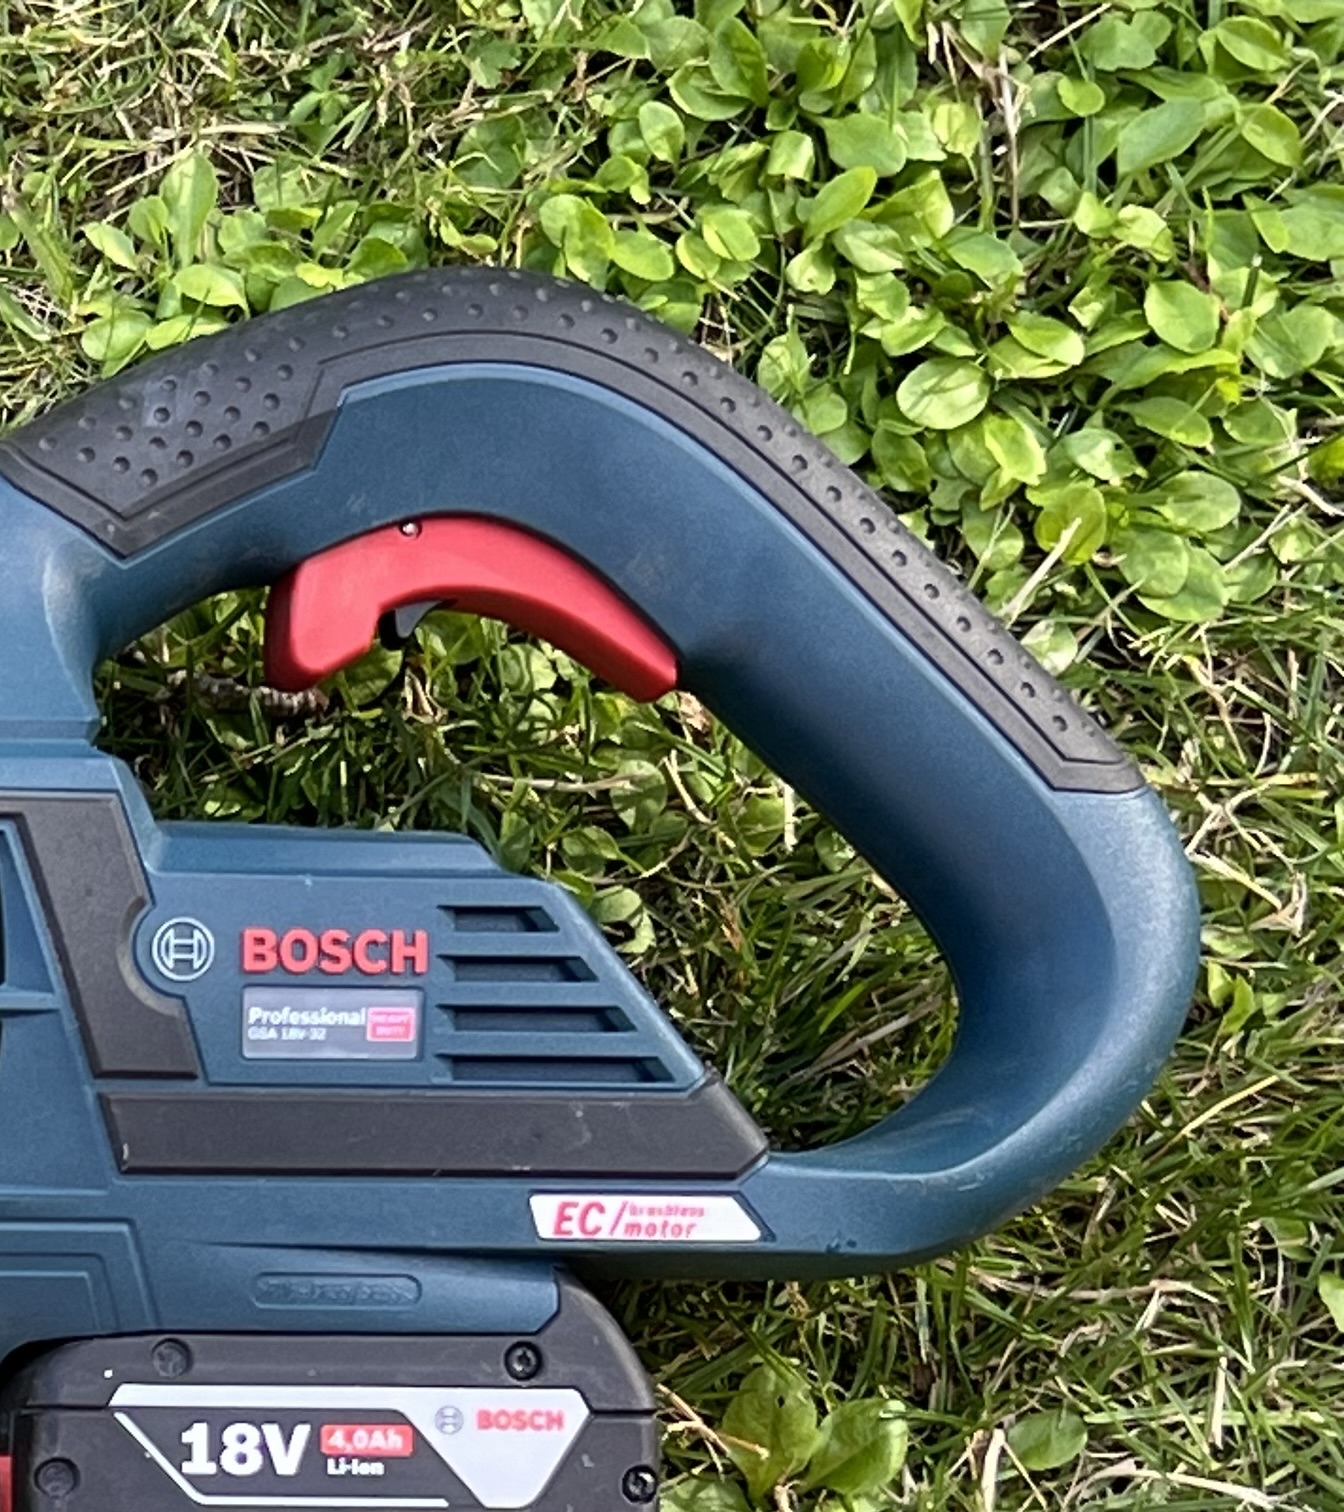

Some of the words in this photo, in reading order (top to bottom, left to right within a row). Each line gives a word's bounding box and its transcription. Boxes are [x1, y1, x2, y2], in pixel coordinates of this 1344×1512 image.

[241, 928, 428, 976] BOSCH
[248, 1006, 366, 1026] Professional
[248, 1027, 278, 1040] GSA
[624, 1221, 697, 1238] motor
[477, 1409, 564, 1431] BOSCH
[180, 1421, 311, 1477] 18V
[327, 1429, 403, 1454] 4,0Ah
